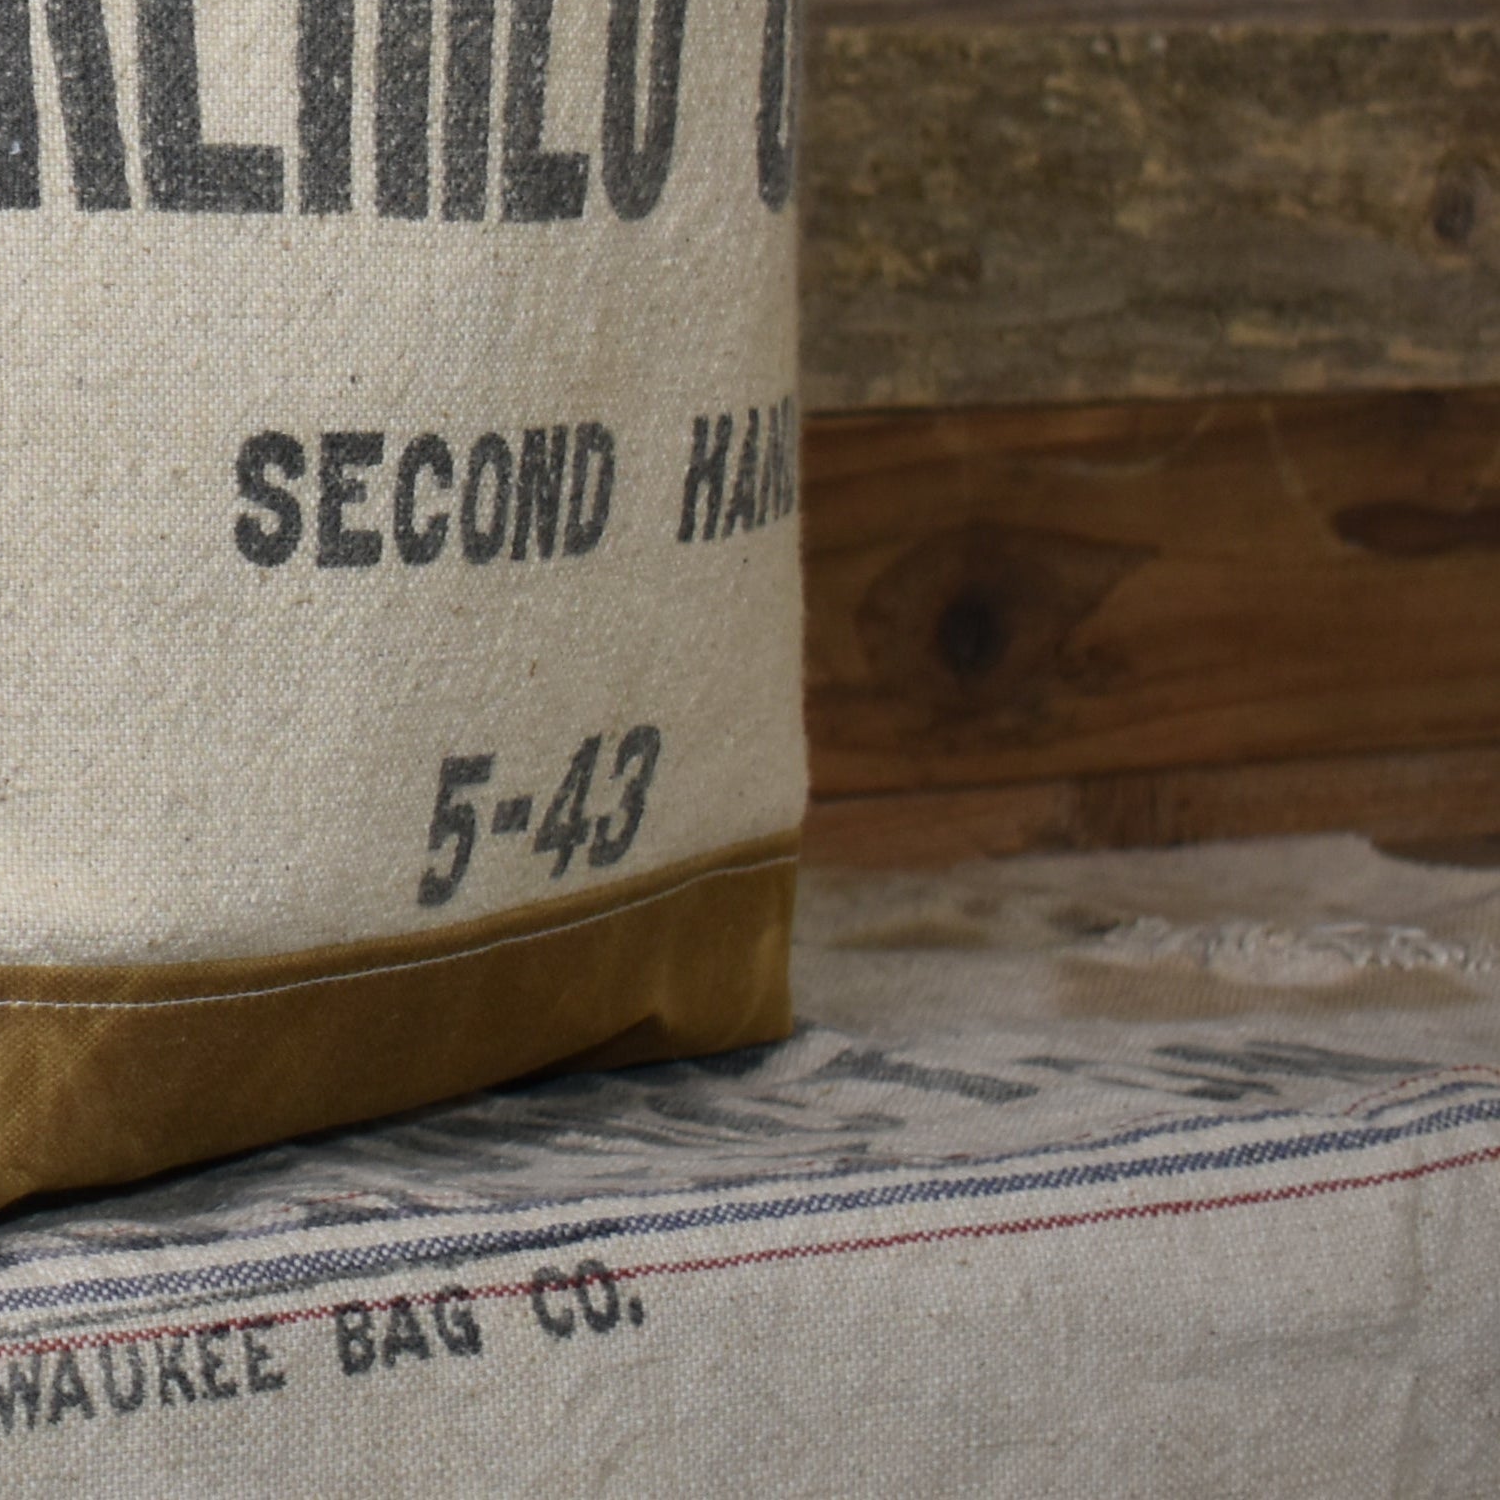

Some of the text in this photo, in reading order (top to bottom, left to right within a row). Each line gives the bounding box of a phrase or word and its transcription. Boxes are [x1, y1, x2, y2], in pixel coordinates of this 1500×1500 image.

[233, 421, 616, 568] SECOND
[417, 725, 661, 907] 5-43
[336, 1284, 483, 1376] BAG
[532, 1258, 645, 1340] CO.
